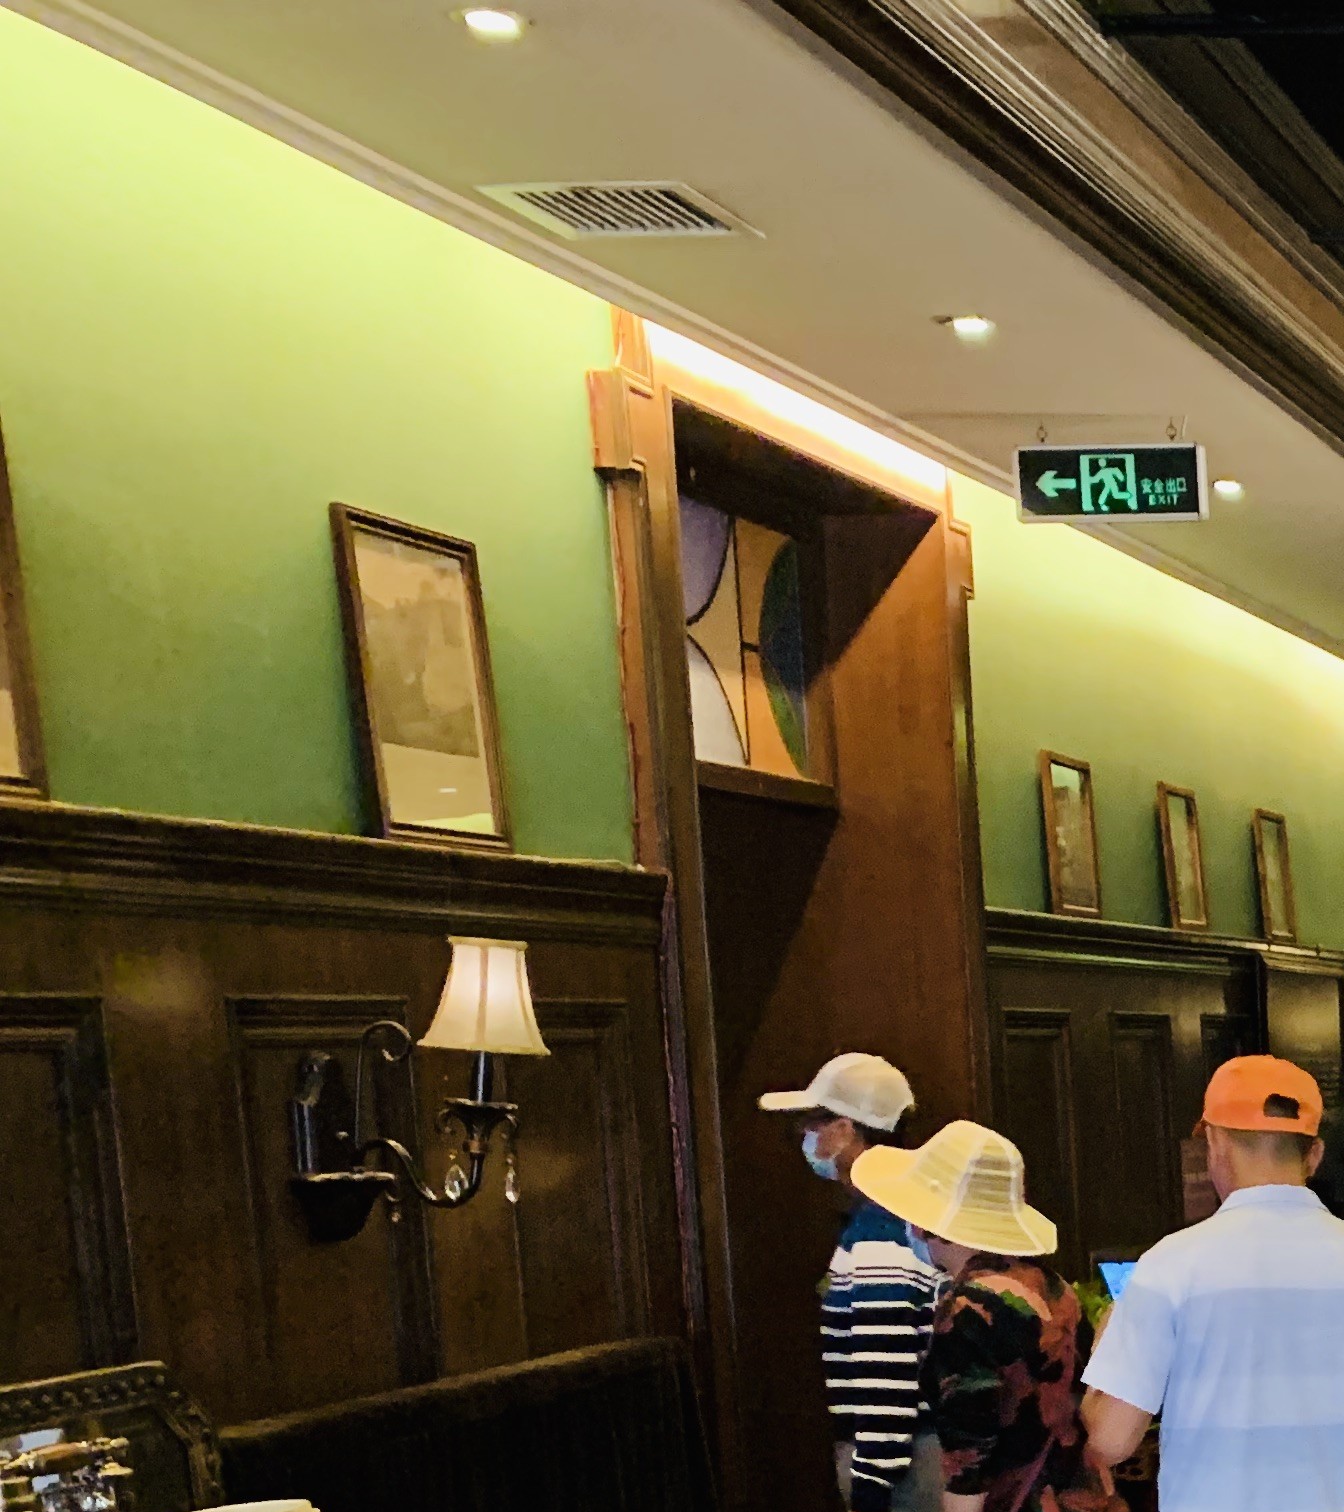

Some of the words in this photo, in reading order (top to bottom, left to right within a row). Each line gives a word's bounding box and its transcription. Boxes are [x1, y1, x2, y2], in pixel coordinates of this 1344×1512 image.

[1140, 477, 1188, 494] 安全出口
[1148, 493, 1178, 506] EXIT
